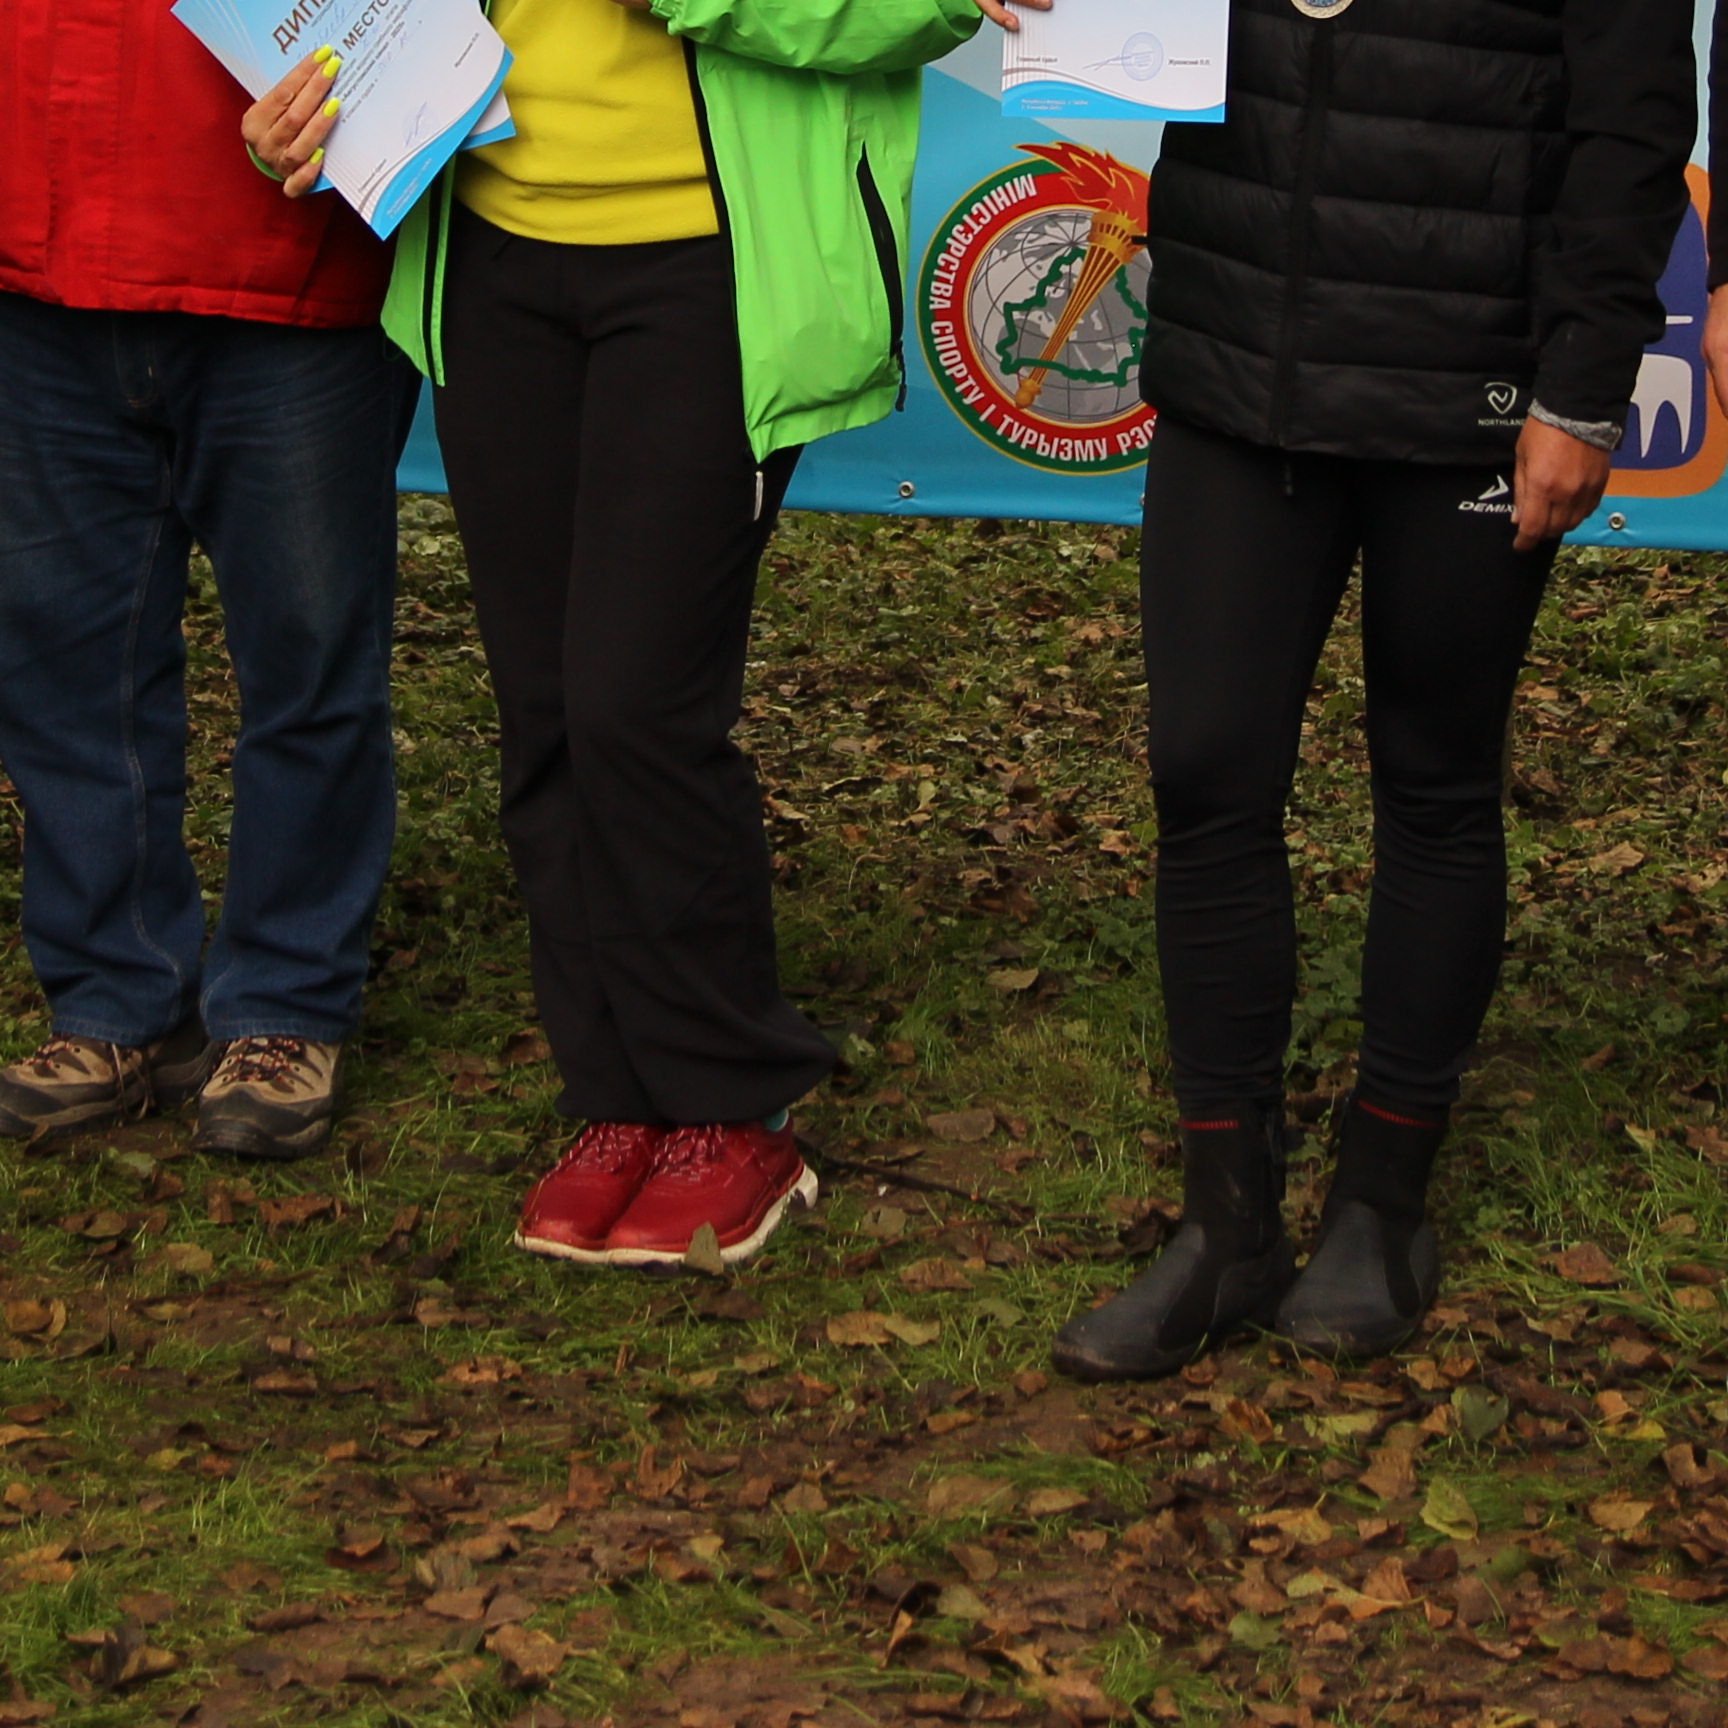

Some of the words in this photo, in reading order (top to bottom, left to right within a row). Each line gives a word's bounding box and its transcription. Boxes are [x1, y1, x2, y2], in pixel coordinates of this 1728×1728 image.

[929, 173, 1038, 311] МІНІСТЭРСТВА
[930, 320, 987, 406] СПОРТУ
[995, 414, 1109, 464] ТУРЫЗМУ
